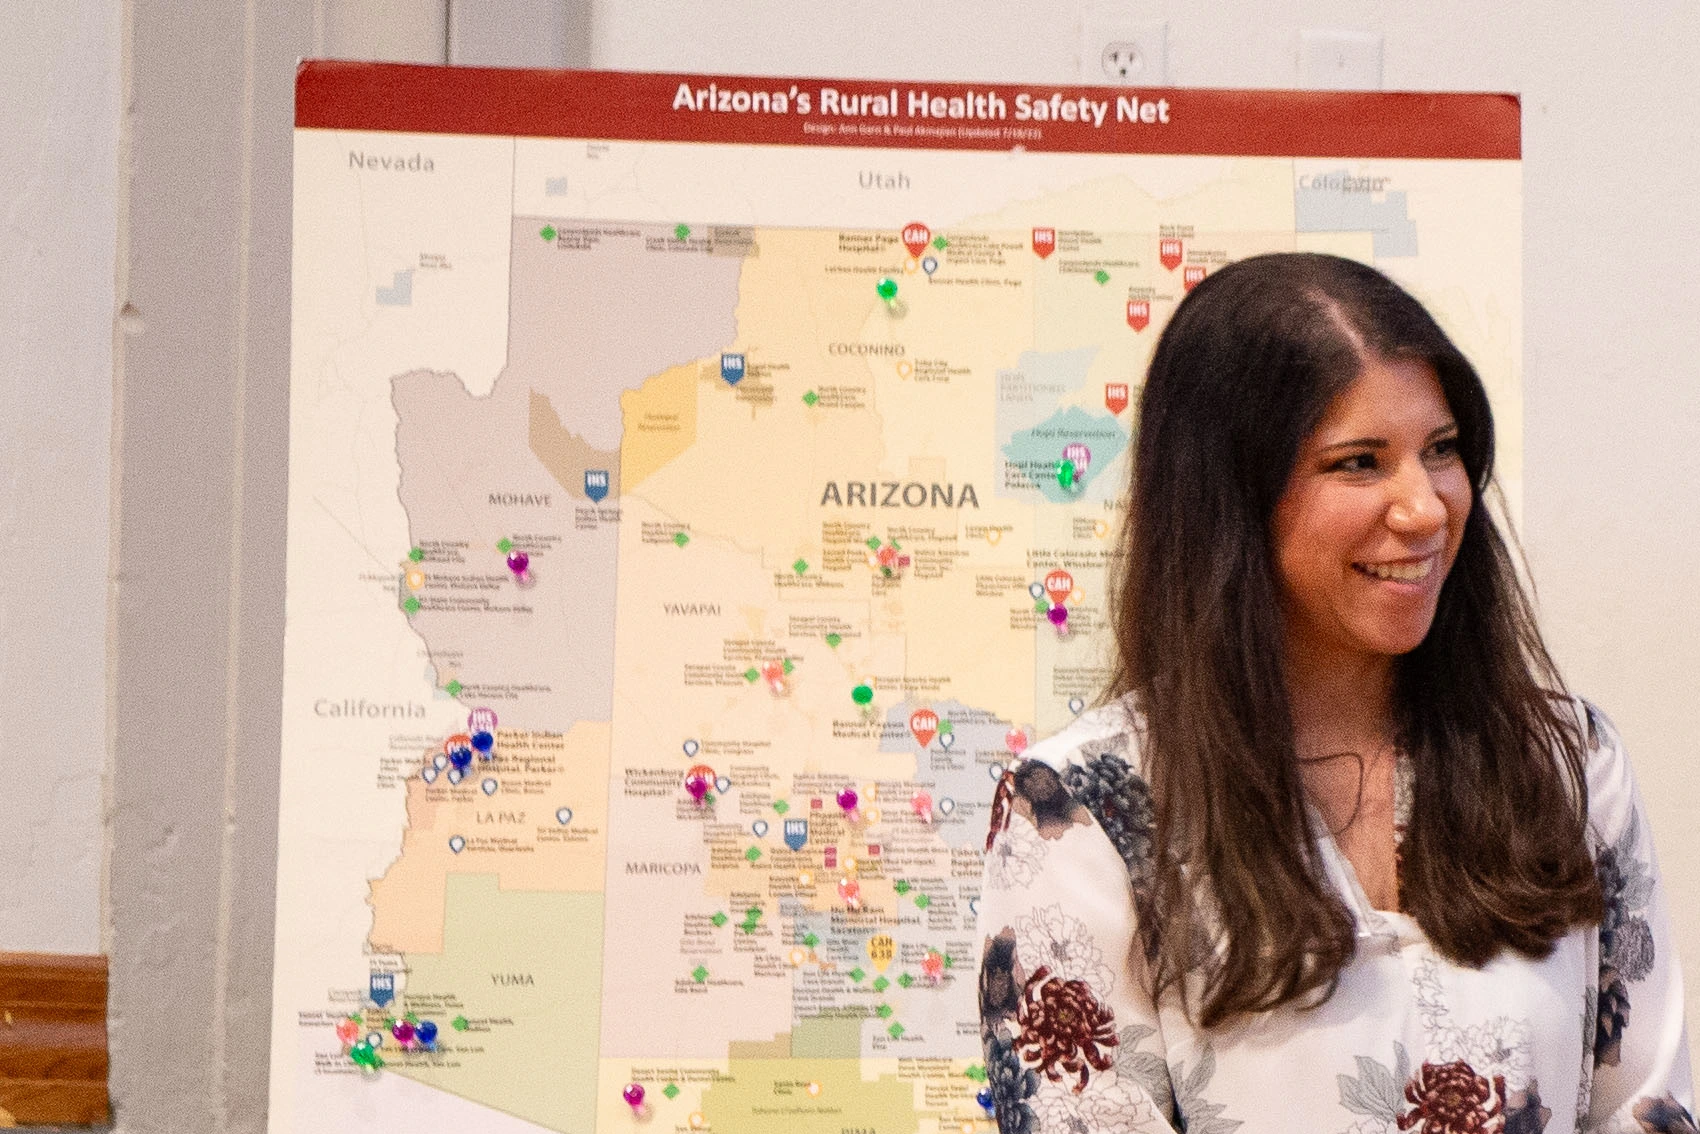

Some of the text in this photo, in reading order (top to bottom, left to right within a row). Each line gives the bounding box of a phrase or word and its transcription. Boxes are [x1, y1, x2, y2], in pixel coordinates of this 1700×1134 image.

[673, 83, 1170, 128] Arizona's Rural Health Safety Net
[348, 151, 435, 173] Nevada
[859, 171, 911, 190] Utah
[828, 343, 906, 356] COCONINO
[488, 493, 552, 507] MOHAVE
[820, 480, 980, 509] ARIZONA
[314, 698, 426, 719] California
[911, 716, 937, 730] CAH
[624, 862, 702, 875] MARICOPA
[491, 974, 535, 986] YUMA
